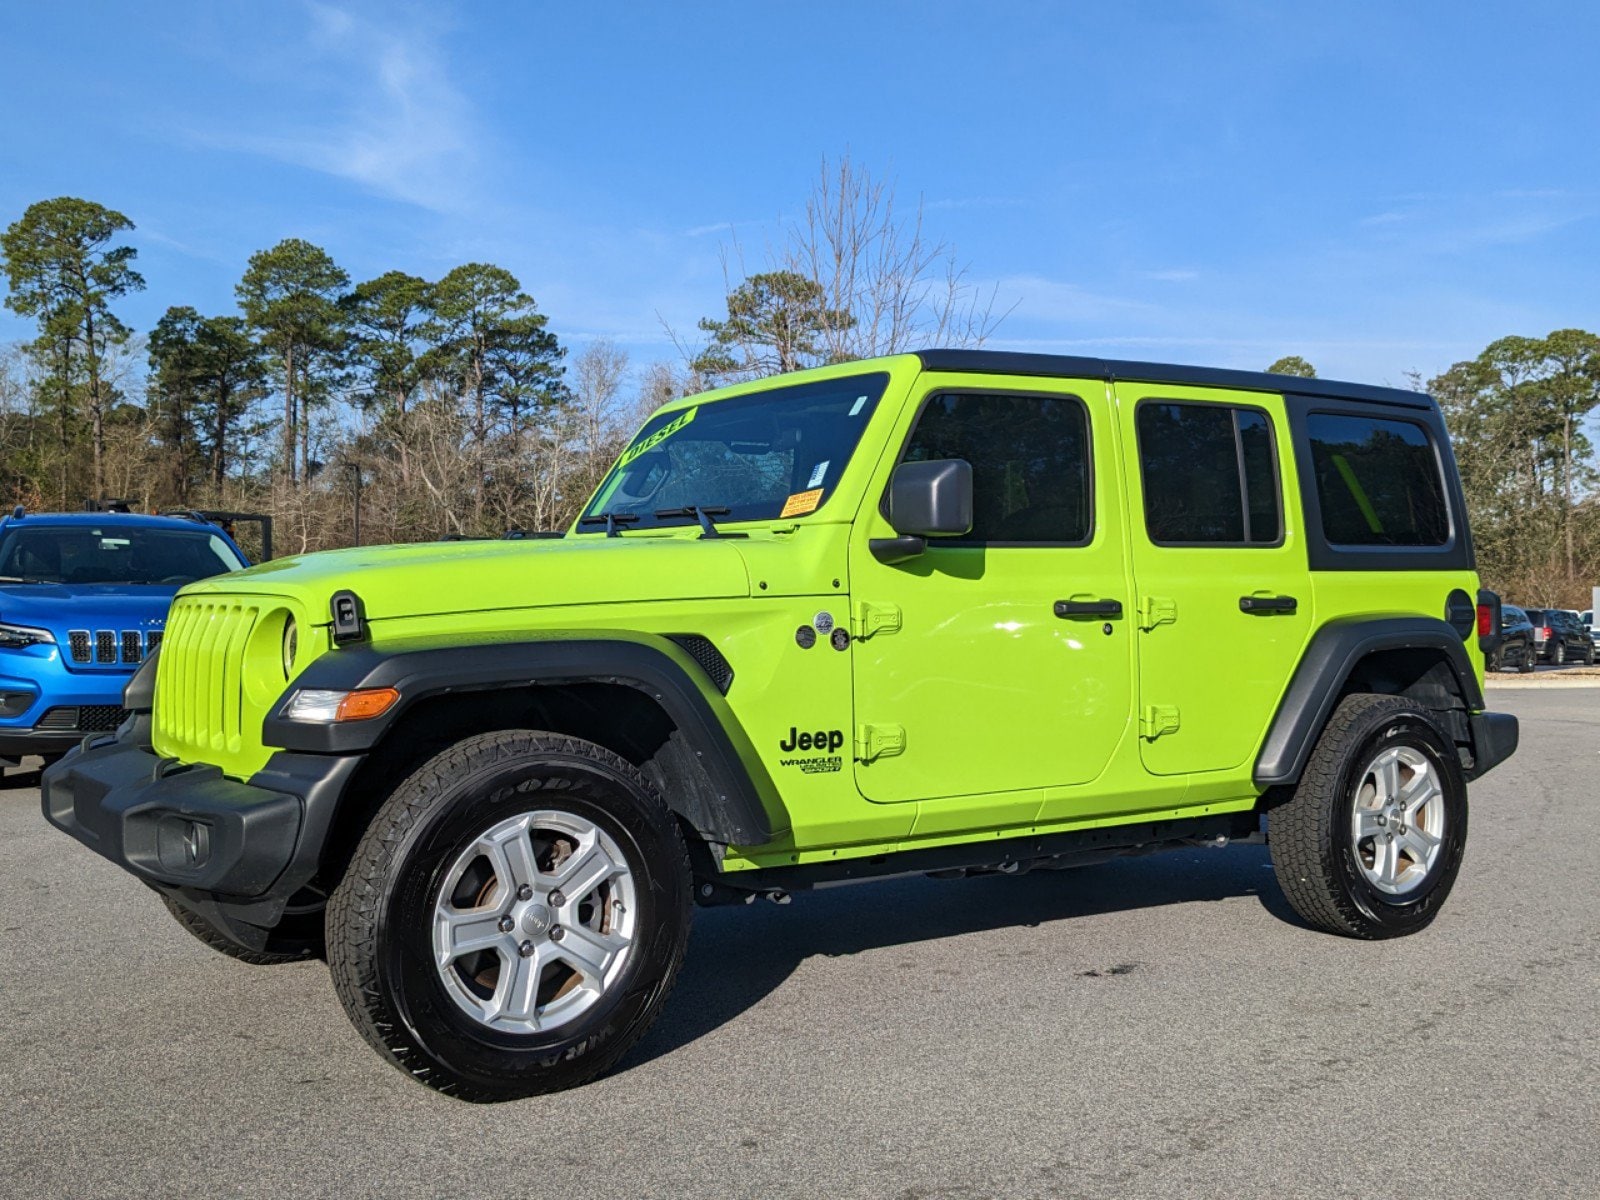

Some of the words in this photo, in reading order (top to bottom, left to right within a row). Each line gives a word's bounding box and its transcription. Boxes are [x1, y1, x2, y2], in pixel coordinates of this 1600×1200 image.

[628, 415, 686, 460] DIESEL
[780, 727, 843, 753] Jeep
[779, 756, 842, 767] WRANGLER
